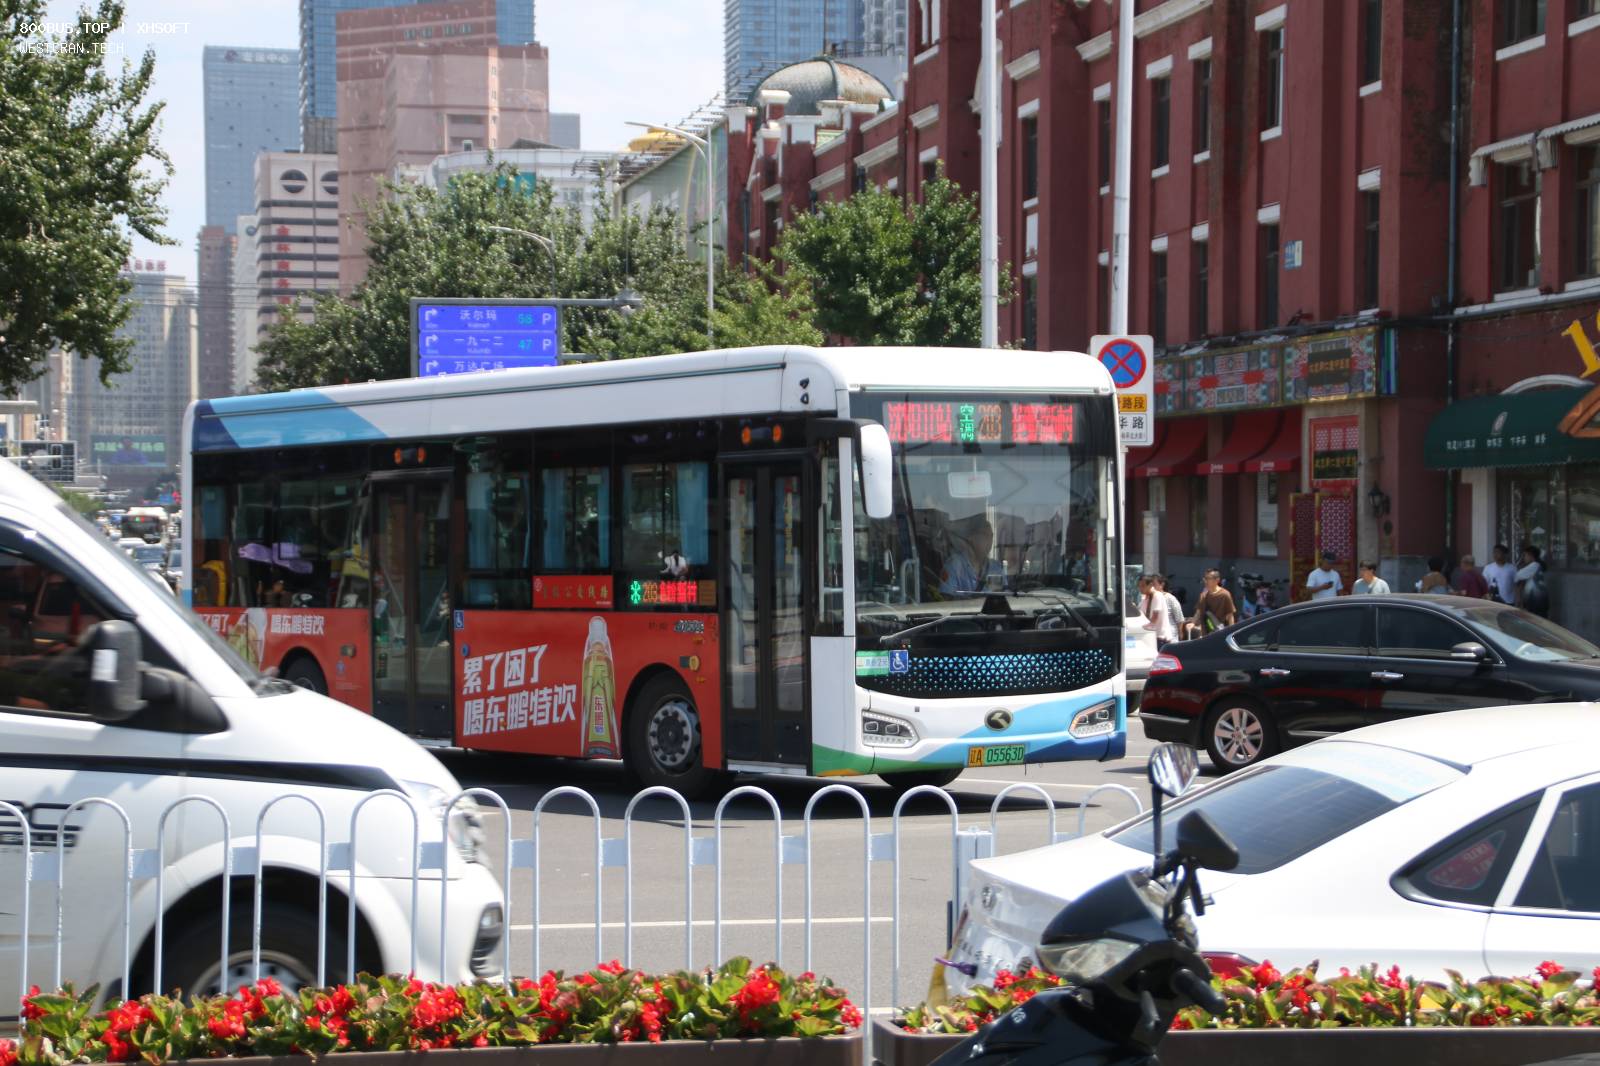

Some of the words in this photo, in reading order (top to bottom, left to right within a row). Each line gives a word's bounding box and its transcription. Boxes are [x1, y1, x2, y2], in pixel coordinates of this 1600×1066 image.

[459, 310, 497, 320] 沃尔玛
[542, 312, 552, 325] P
[454, 336, 504, 347] 一九一二
[542, 339, 552, 351] P
[1118, 396, 1145, 410] 路段
[271, 614, 325, 636] 喝东鹏特饮
[462, 644, 548, 695] 累了困了
[462, 683, 577, 736] 喝东鹏特饮
